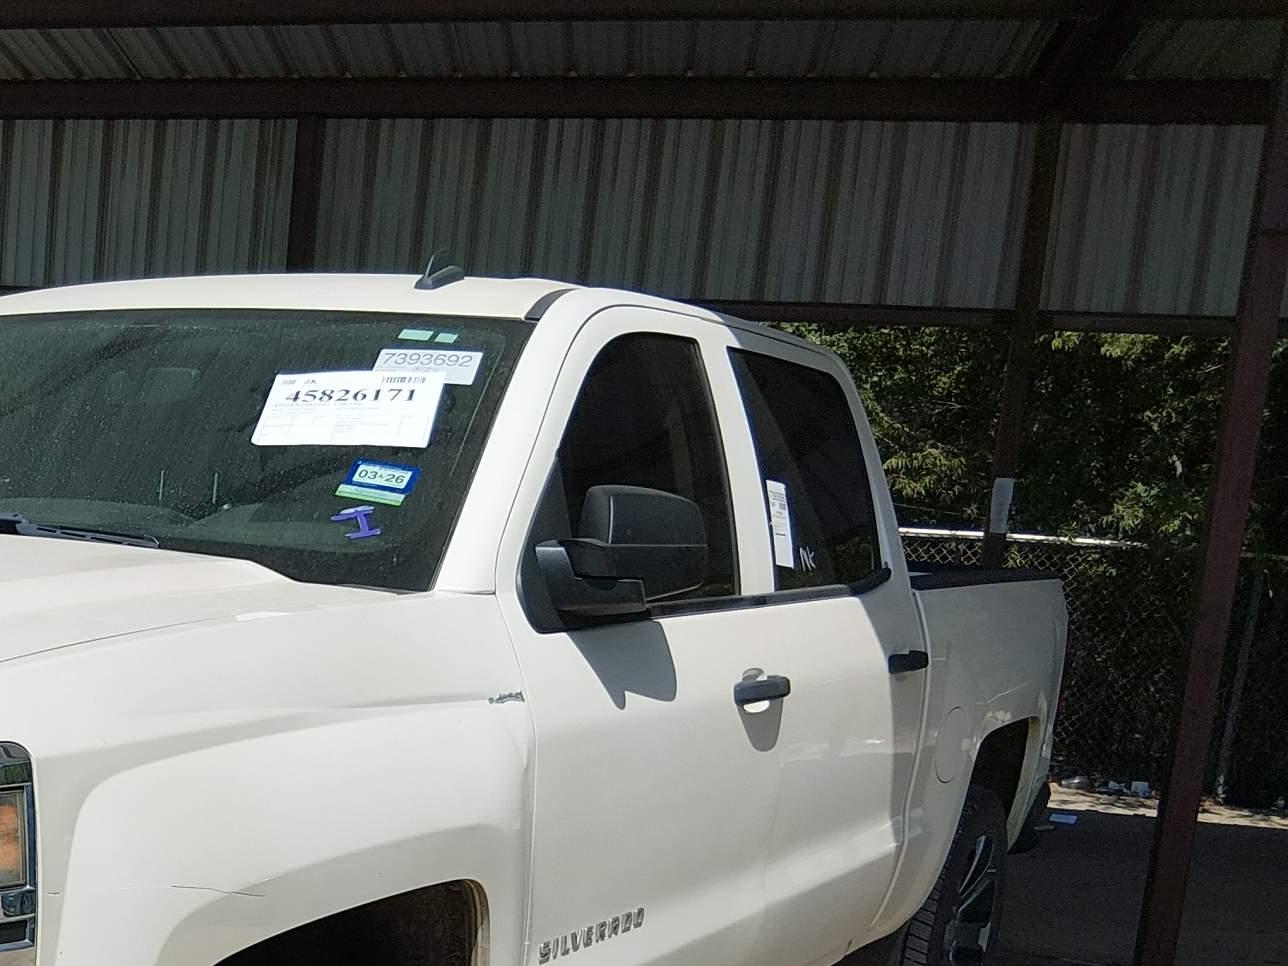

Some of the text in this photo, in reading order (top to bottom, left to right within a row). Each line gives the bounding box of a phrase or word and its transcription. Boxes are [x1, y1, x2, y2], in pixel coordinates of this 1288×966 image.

[383, 352, 474, 368] 7393692
[285, 388, 417, 403] 45826171
[537, 907, 645, 966] SILVERADO
